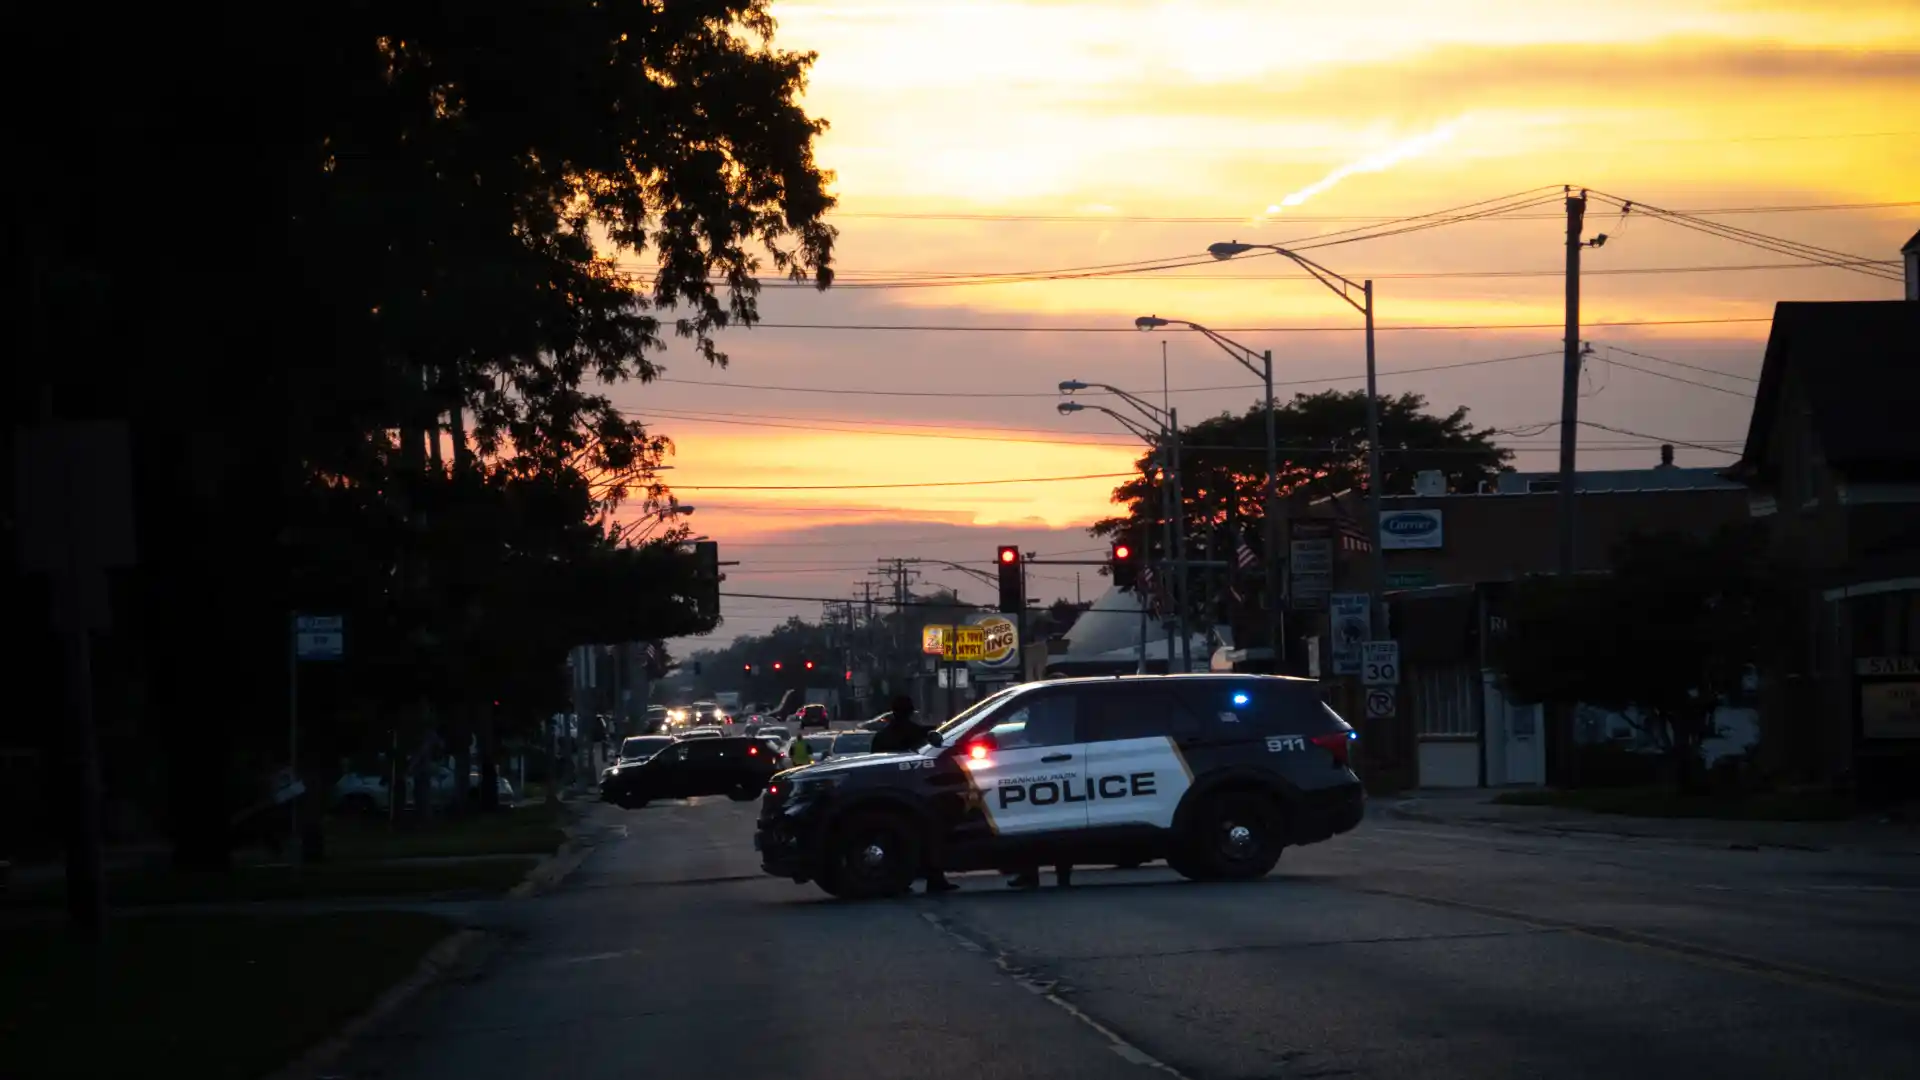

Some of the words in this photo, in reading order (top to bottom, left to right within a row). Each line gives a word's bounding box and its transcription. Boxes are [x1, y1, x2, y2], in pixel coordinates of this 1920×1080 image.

[1389, 518, 1432, 531] Carrier
[984, 624, 1011, 640] RGER
[944, 644, 982, 655] PNTRY
[985, 633, 1014, 652] ING
[1367, 664, 1395, 680] 30
[1266, 738, 1306, 753] 911
[998, 774, 1048, 785] FRANKLIN
[998, 772, 1157, 809] POLICE
